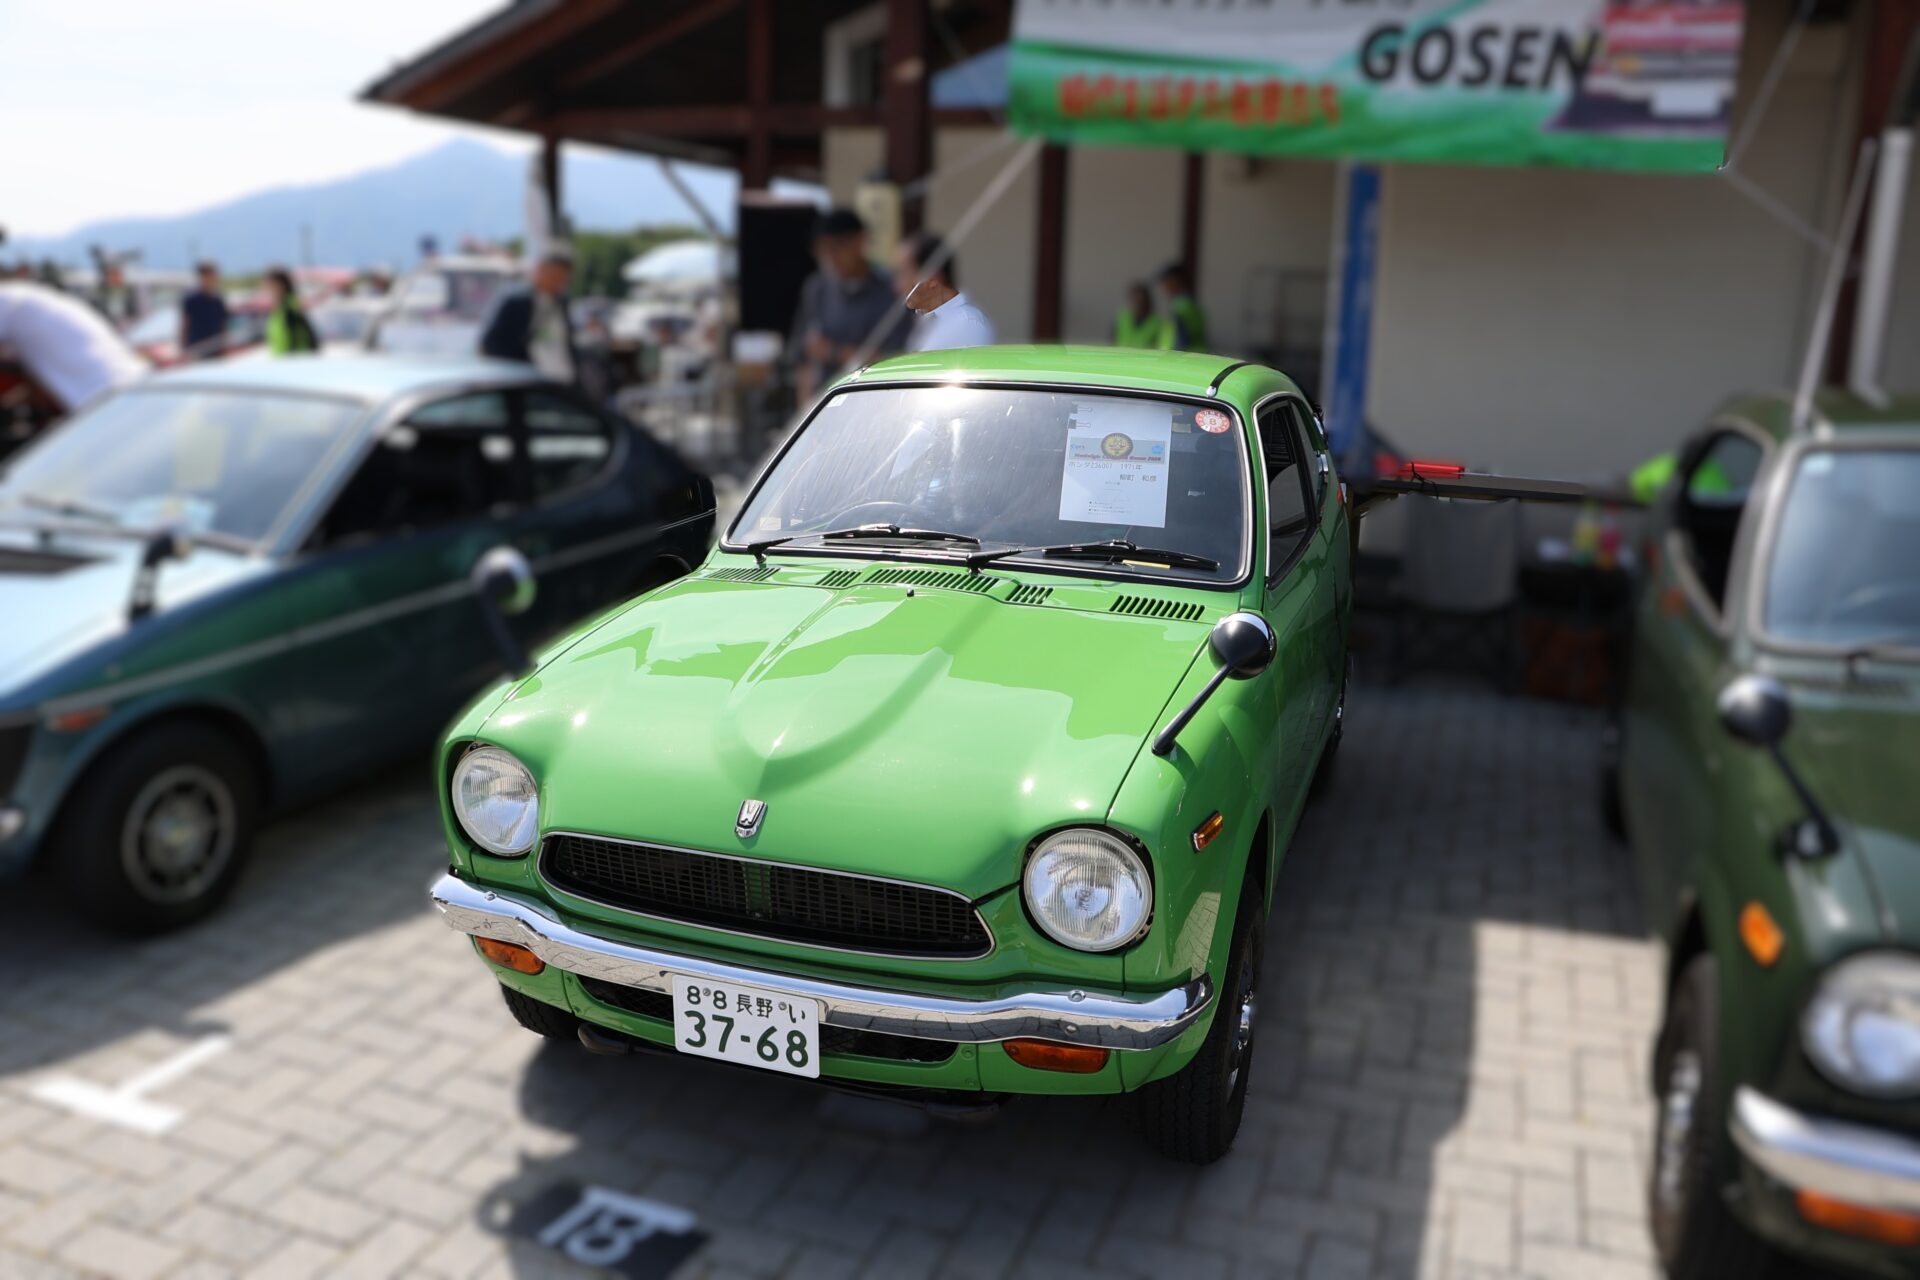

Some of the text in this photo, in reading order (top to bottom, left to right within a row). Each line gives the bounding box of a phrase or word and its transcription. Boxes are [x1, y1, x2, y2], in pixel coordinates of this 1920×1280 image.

[1360, 23, 1600, 89] GOSEN
[687, 985, 806, 1024] 88 長野 い
[684, 1010, 809, 1068] 37-68
